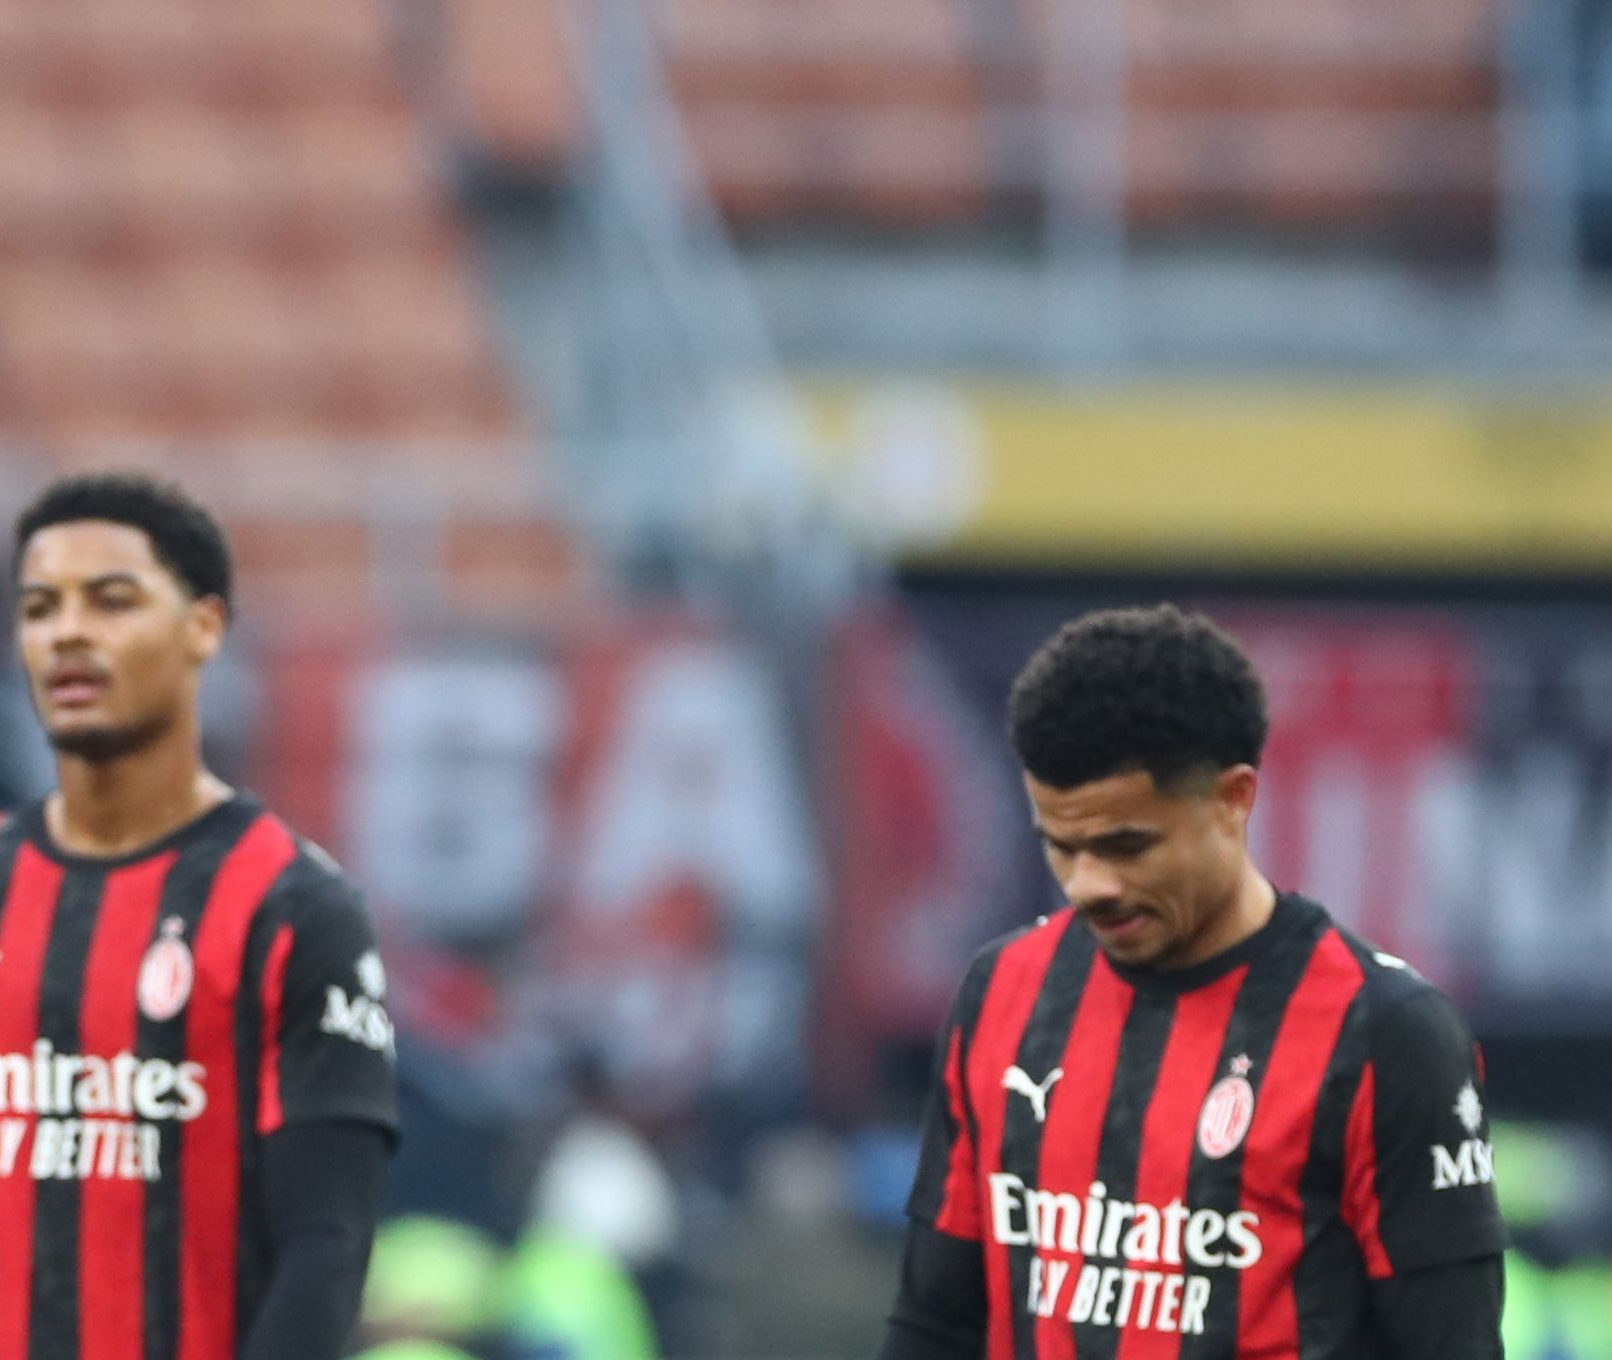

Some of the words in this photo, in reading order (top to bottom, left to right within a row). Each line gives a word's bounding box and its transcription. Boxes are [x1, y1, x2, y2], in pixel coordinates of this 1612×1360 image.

[320, 984, 397, 1058] MS
[28, 1117, 163, 1182] BETTER
[1430, 1138, 1495, 1191] MS
[988, 1173, 1263, 1270] Emirates
[1027, 1255, 1070, 1318] FLY
[1067, 1263, 1212, 1336] BETTER
